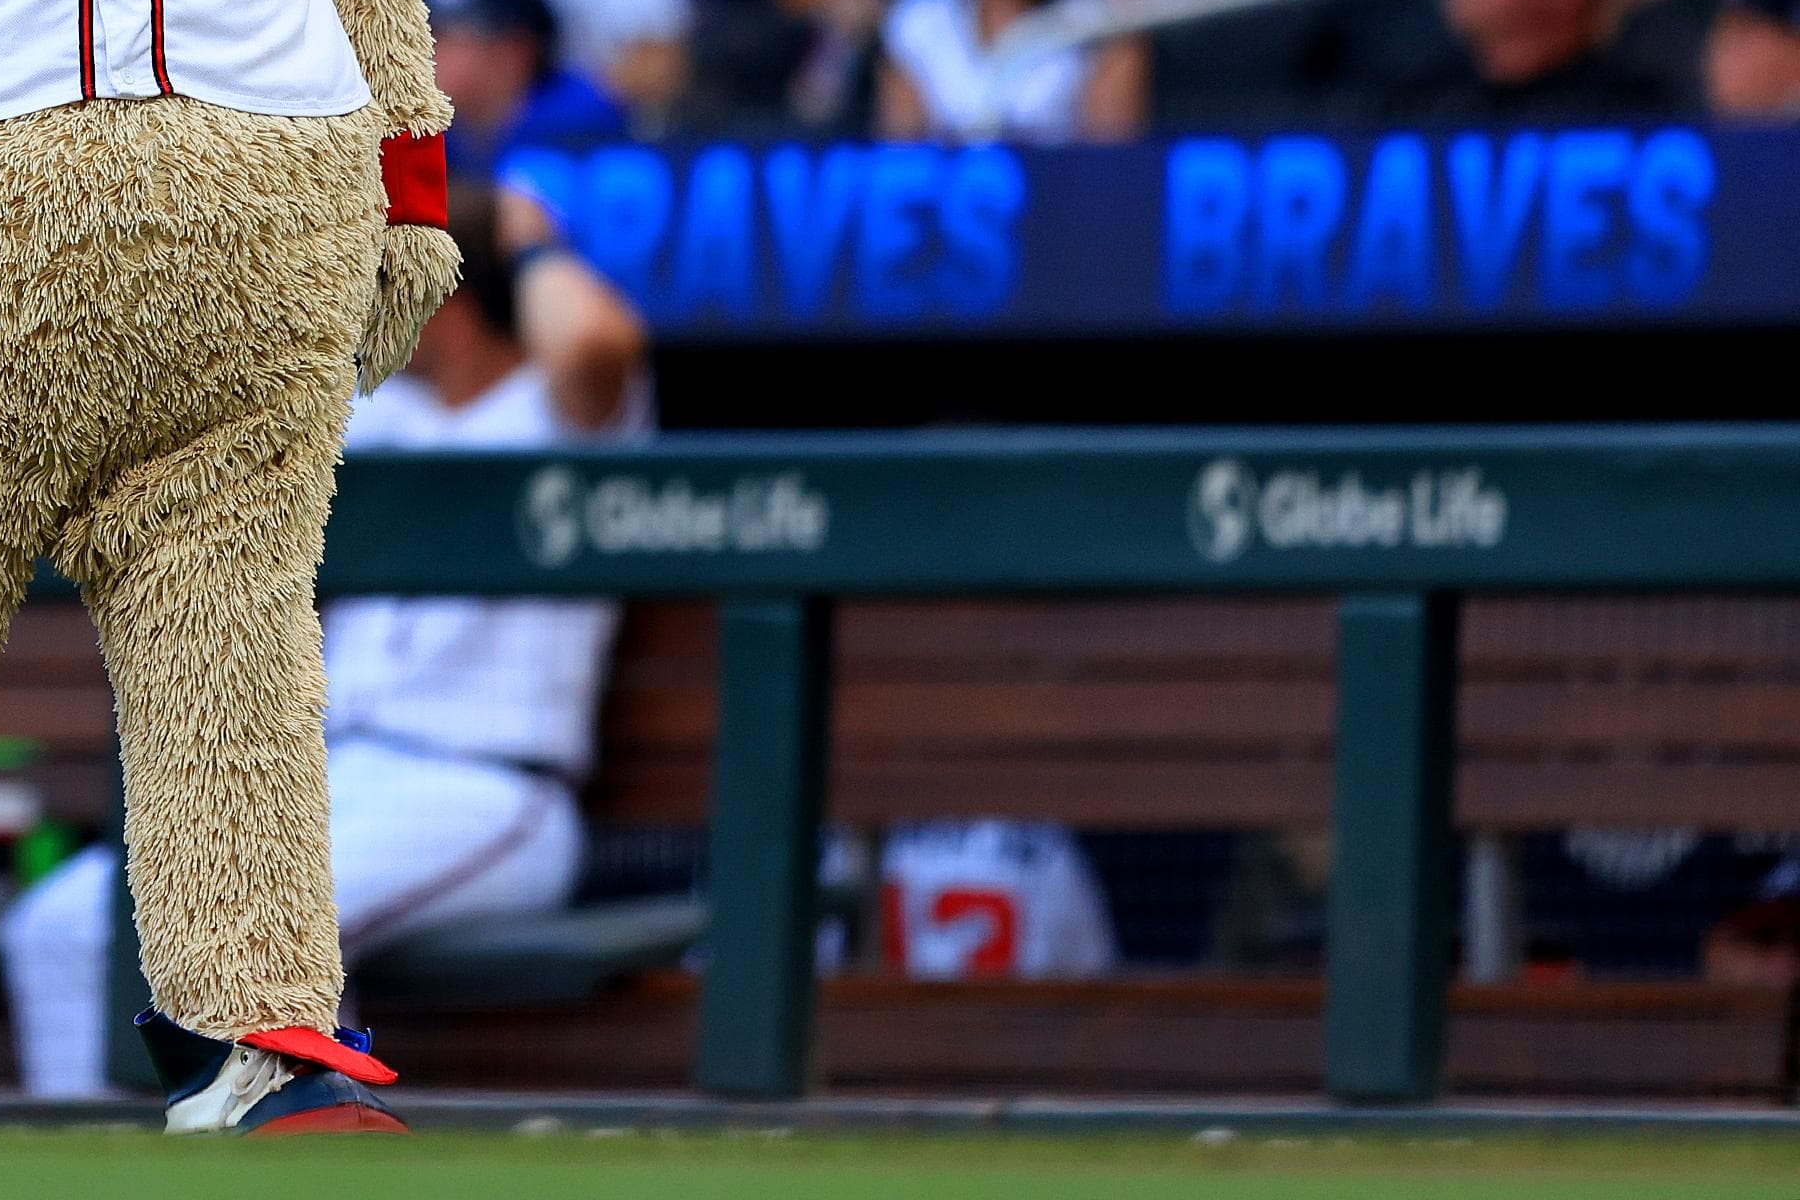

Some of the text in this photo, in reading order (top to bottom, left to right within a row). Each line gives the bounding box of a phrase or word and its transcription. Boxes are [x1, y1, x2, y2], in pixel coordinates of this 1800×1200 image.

[1162, 128, 1716, 317] BRAVES
[586, 470, 829, 555] Globe Life
[1256, 465, 1507, 548] Globe Life
